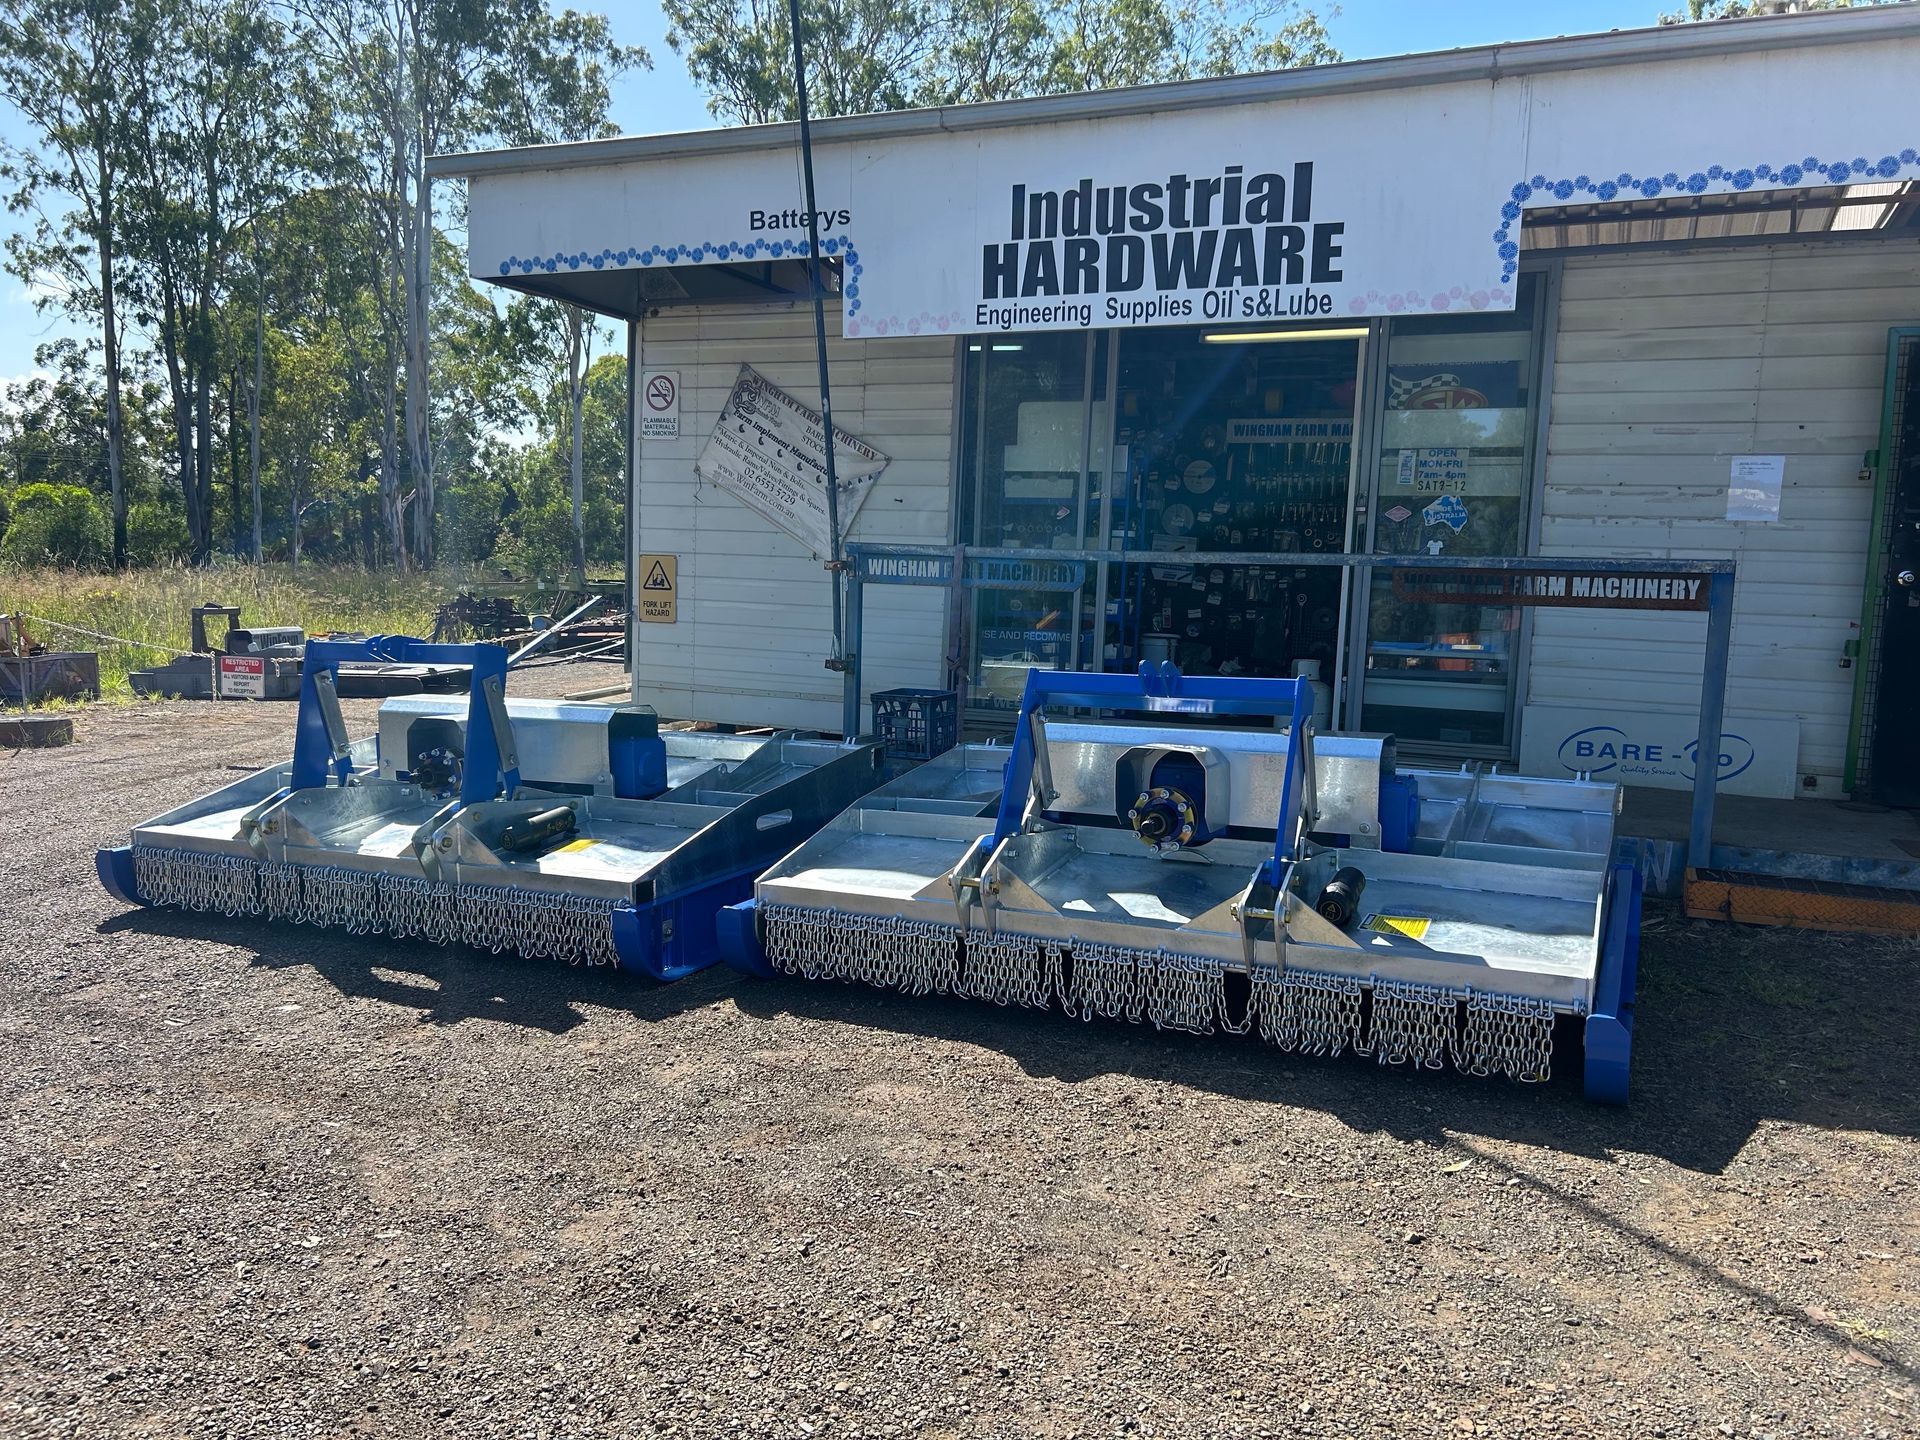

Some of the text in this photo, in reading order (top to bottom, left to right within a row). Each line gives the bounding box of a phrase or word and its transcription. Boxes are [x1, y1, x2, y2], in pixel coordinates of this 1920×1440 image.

[1010, 161, 1314, 241] Industrial
[750, 209, 851, 232] Batterys
[981, 222, 1345, 300] HARDWARE
[975, 299, 1092, 329] Engineering
[1105, 295, 1193, 322] Supplies
[752, 375, 794, 409] WINGHAM
[795, 405, 823, 427] FARM
[822, 422, 878, 461] ACHINERY
[734, 409, 753, 426] Farm
[752, 422, 791, 451] Implement
[1233, 423, 1292, 437] WINGHAM
[1295, 423, 1328, 437] FARM
[745, 446, 769, 465] Imperial
[769, 460, 782, 474] Nuts
[1419, 459, 1463, 468] MON-FRI
[1428, 450, 1457, 458] OPEN
[744, 467, 796, 506] 02 6553 5729
[1427, 511, 1467, 520] AUSTRALIA
[868, 558, 940, 578] WINGHAM
[987, 563, 1078, 583] MACHINERY
[1513, 576, 1566, 598] FARM
[1571, 576, 1701, 601] MACHINERY
[643, 600, 672, 609] FORK LIFT
[645, 608, 670, 617] HAZARD
[999, 631, 1021, 640] AND
[1023, 631, 1085, 643] RECOMMED
[225, 659, 260, 667] RESTRICTED
[1576, 741, 1664, 763] BARE
[1620, 764, 1651, 777] Quality
